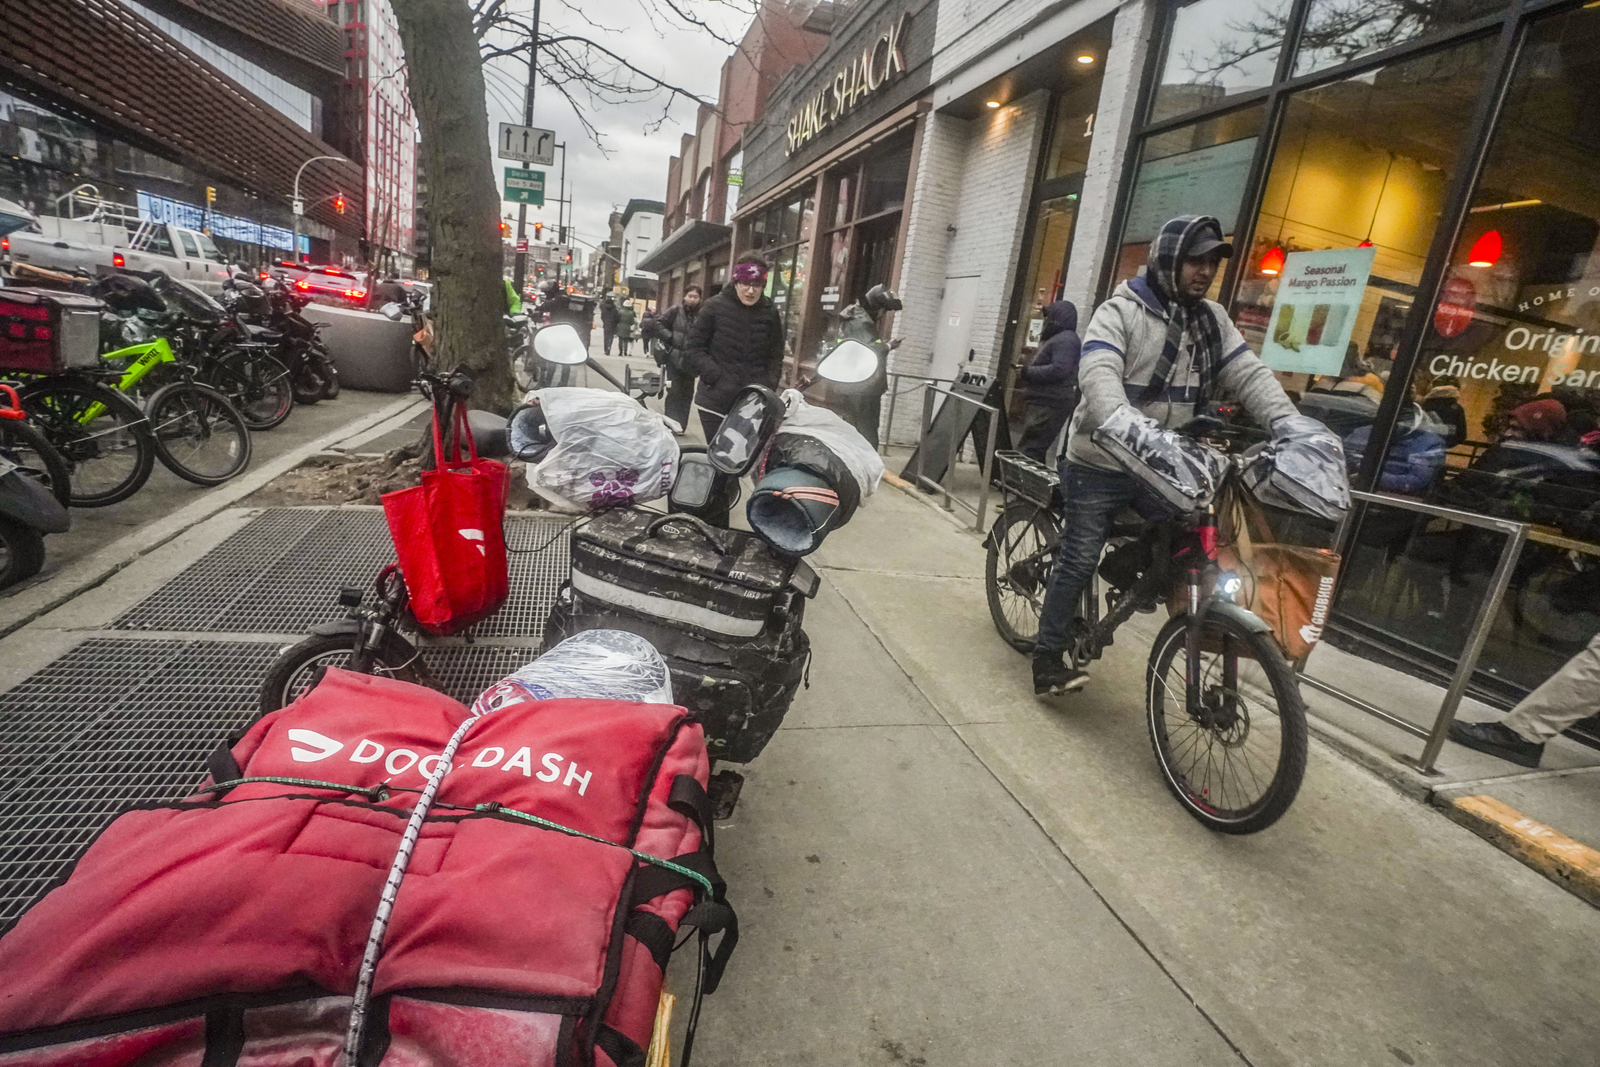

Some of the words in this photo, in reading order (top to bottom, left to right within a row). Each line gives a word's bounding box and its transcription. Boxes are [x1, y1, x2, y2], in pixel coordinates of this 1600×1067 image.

[785, 82, 831, 157] SHAKE
[831, 12, 909, 121] SHACK
[1084, 113, 1094, 137] 1
[535, 155, 551, 163] ONLY
[511, 170, 529, 178] Dean
[1288, 278, 1318, 289] Mango
[1320, 276, 1357, 287] Passion
[1304, 264, 1347, 275] Seasonal
[1518, 287, 1576, 313] HOME
[1505, 327, 1600, 358] Origin
[1429, 355, 1540, 384] Chicken
[1311, 576, 1334, 625] GRUBHUB
[349, 738, 593, 796] DOODASH
